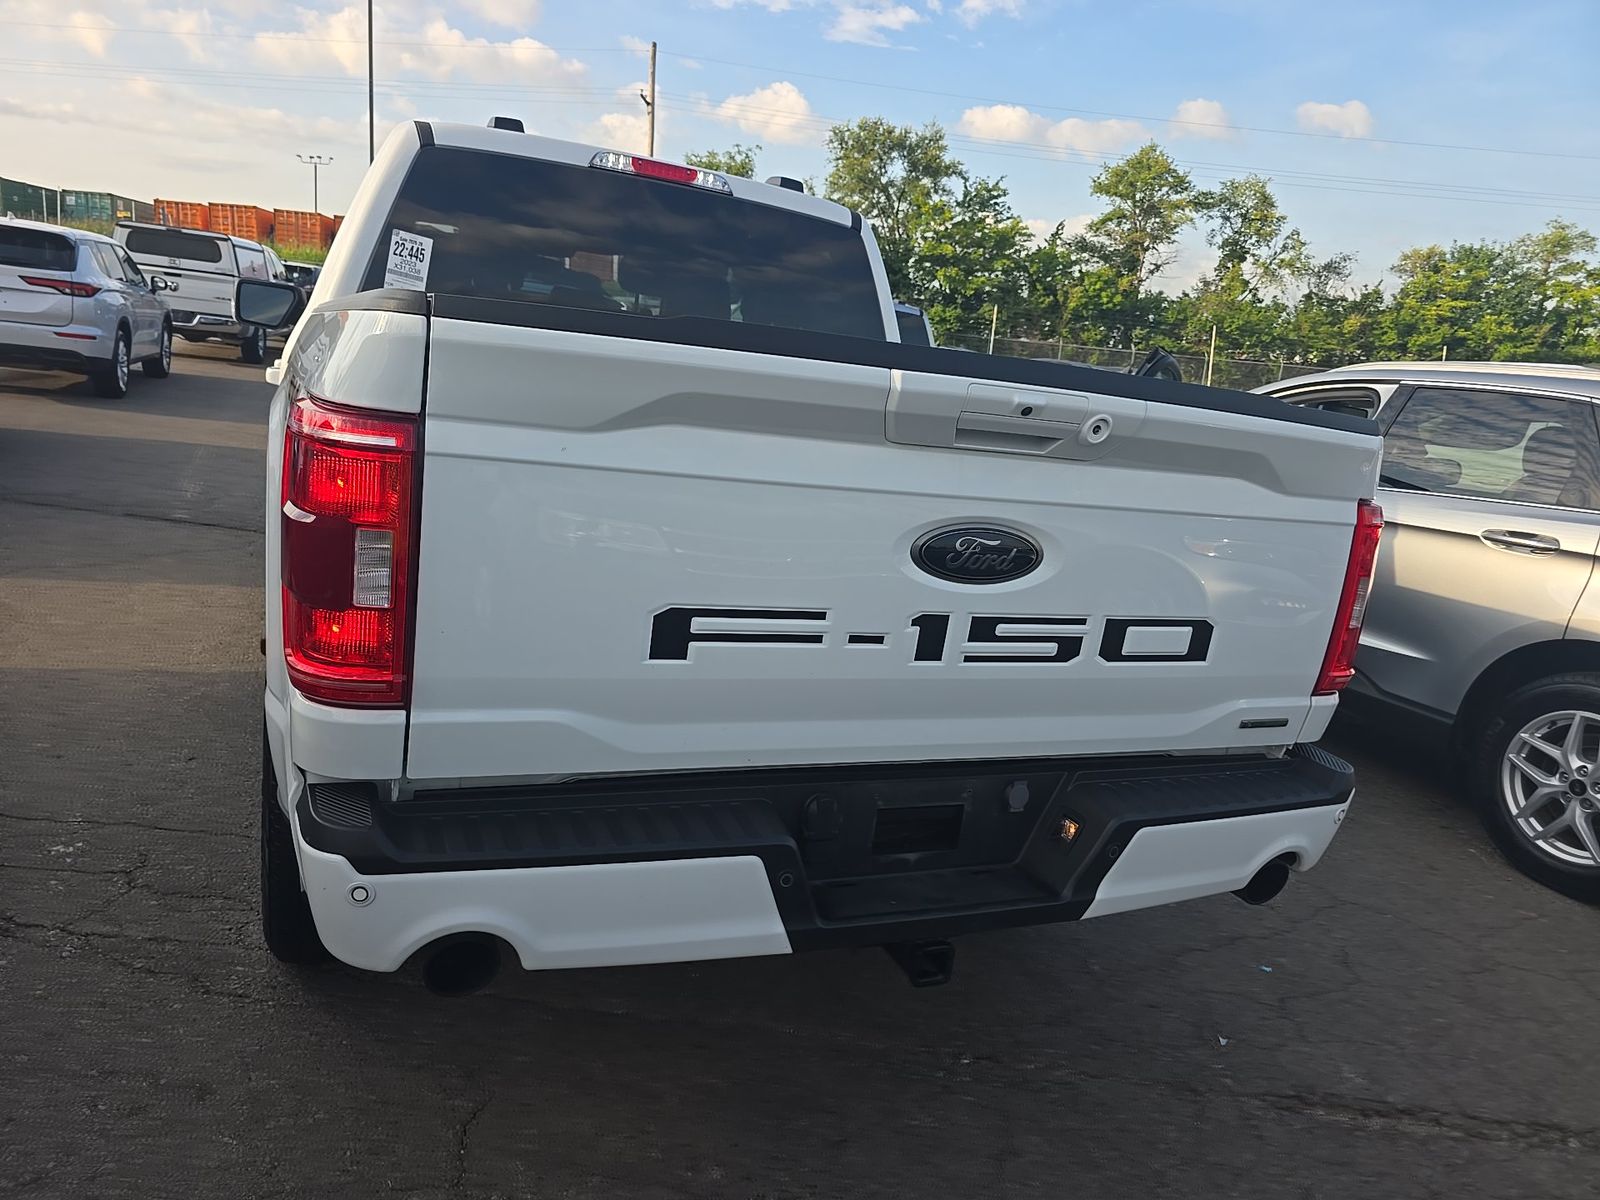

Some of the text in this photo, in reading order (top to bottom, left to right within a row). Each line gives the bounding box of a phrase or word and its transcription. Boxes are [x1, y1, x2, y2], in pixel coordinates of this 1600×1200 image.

[393, 241, 425, 263] 22:445
[400, 259, 417, 267] 2023
[946, 536, 1017, 569] Ford
[648, 606, 1214, 664] F-150
